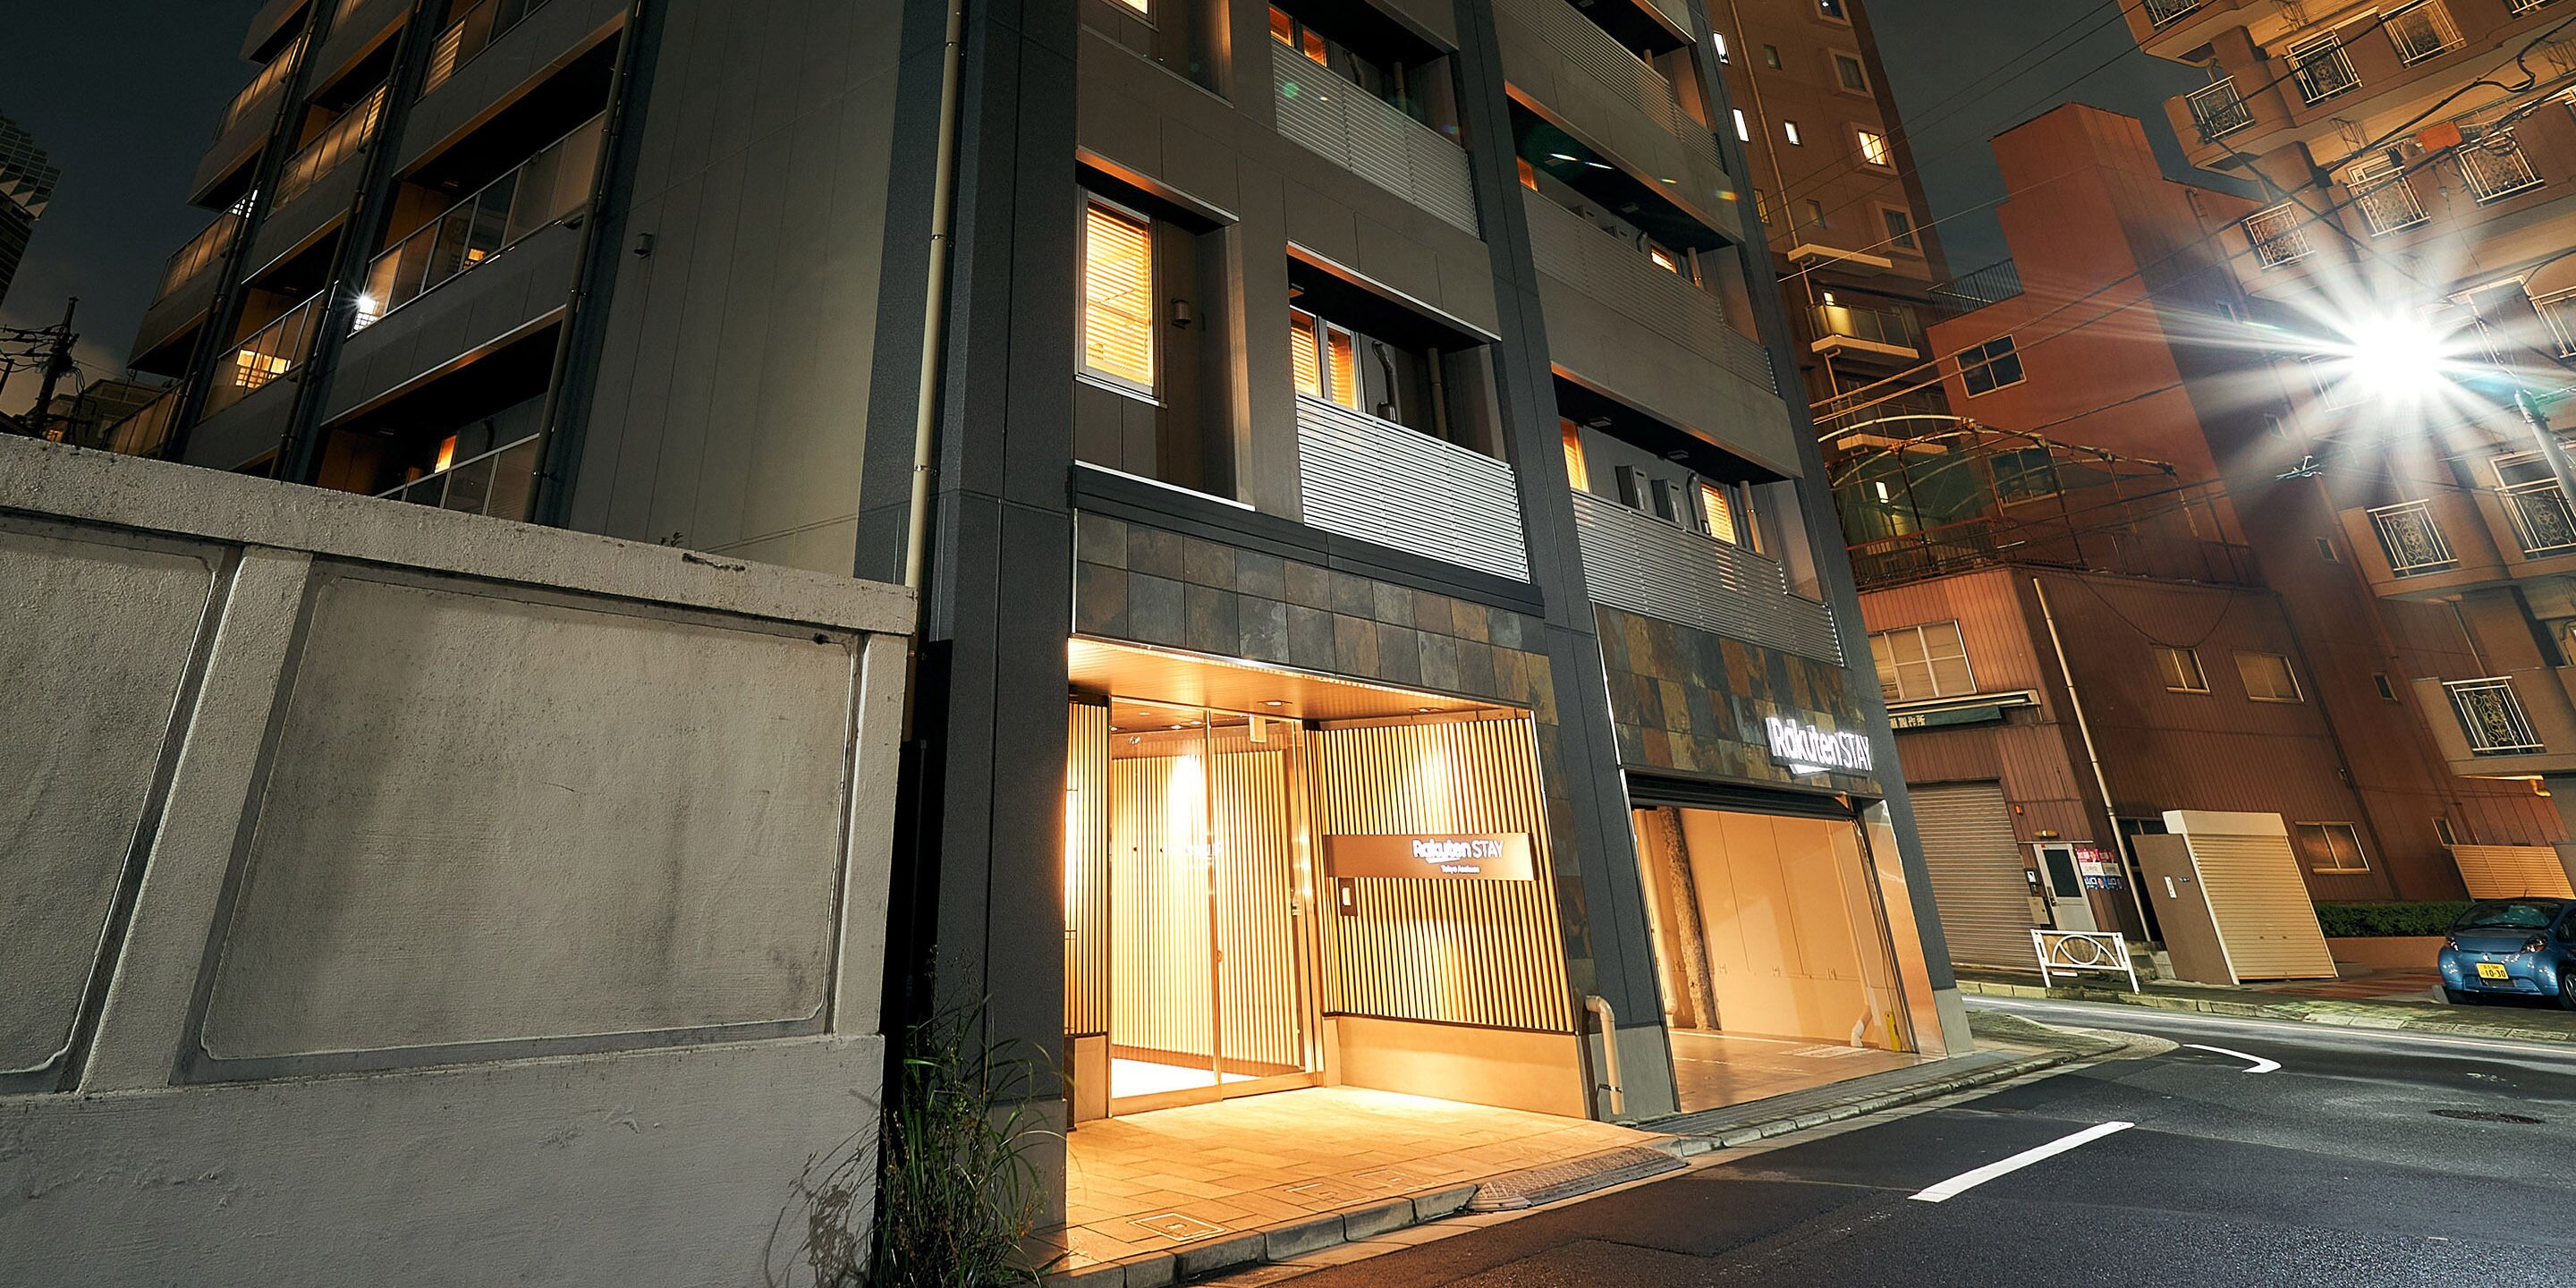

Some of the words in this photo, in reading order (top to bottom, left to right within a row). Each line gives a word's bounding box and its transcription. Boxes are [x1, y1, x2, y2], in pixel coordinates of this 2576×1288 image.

[1766, 716, 1843, 767] Rakuten
[1835, 731, 1873, 771] STAY
[1412, 839, 1471, 858] Rakuten
[1471, 839, 1504, 859] STAY
